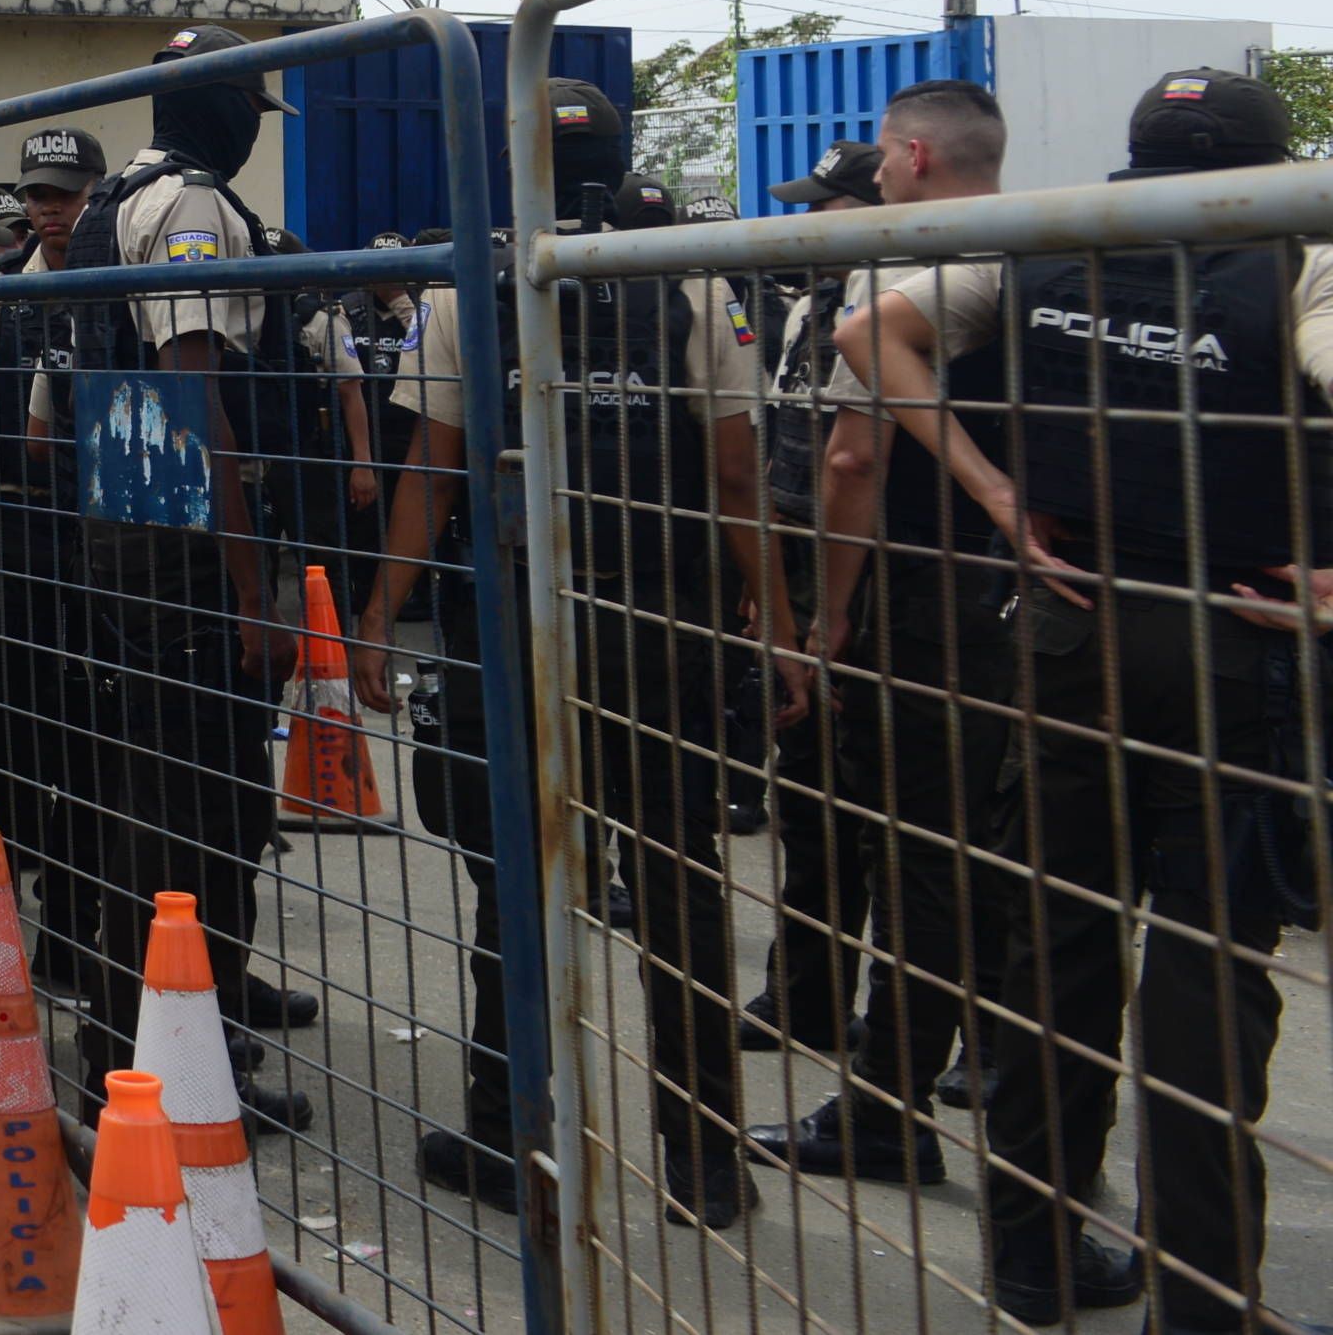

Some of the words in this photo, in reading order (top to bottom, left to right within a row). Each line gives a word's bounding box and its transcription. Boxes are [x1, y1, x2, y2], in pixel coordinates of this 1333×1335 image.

[38, 154, 78, 163] NACIONAL
[169, 234, 216, 244] ECUADOR
[2, 1120, 47, 1292] POLICIA
